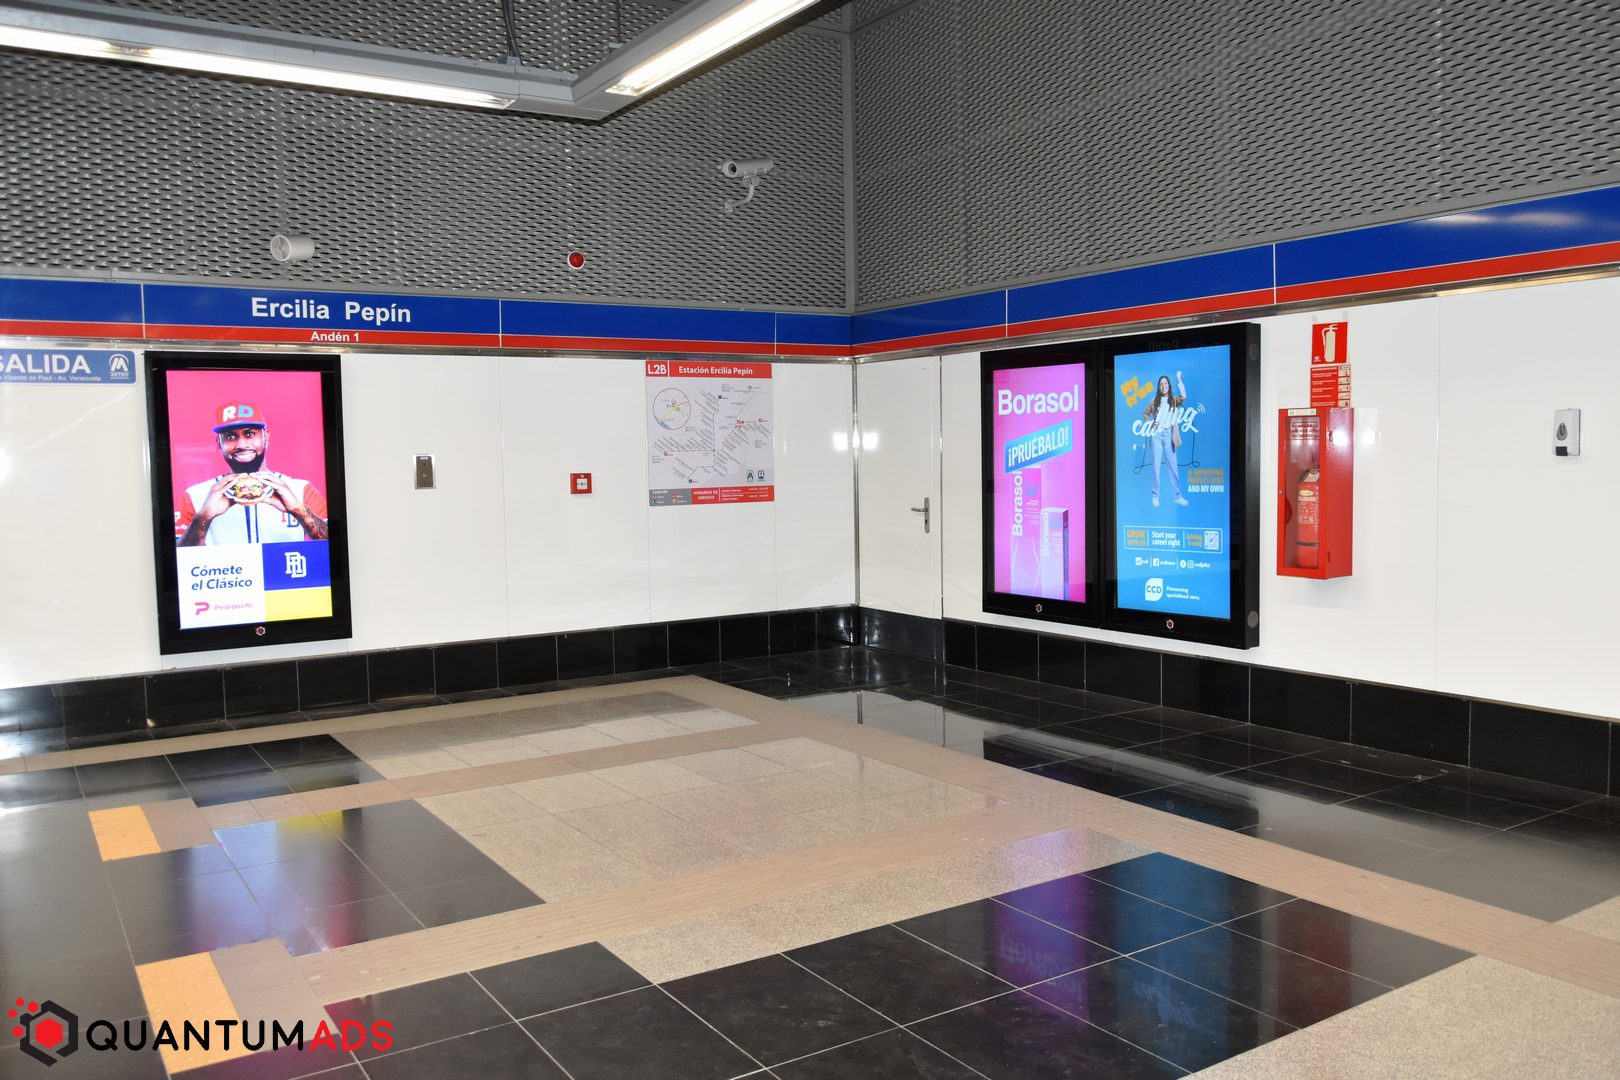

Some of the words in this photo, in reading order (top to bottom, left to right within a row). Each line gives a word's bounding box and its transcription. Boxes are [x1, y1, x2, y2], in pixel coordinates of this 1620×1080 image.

[251, 297, 330, 319] Ercilia
[345, 301, 411, 326] Pepín
[310, 331, 350, 342] Andén
[353, 332, 359, 342] 1
[0, 353, 92, 374] ALIDA
[647, 364, 667, 375] L2B
[678, 365, 709, 375] Estación
[710, 366, 732, 375] Ercilia
[998, 384, 1079, 416] Borasol
[222, 405, 254, 422] RD
[1008, 425, 1069, 467] ¡PRUÉBALO!
[1187, 485, 1200, 493] AND
[1200, 485, 1210, 493] MY
[1210, 485, 1225, 493] OWN
[1012, 471, 1023, 537] Borasol
[1151, 531, 1165, 539] Start
[190, 565, 243, 577] Cómete
[191, 579, 203, 591] el
[206, 577, 253, 590] Clásico
[1146, 585, 1162, 593] CCD
